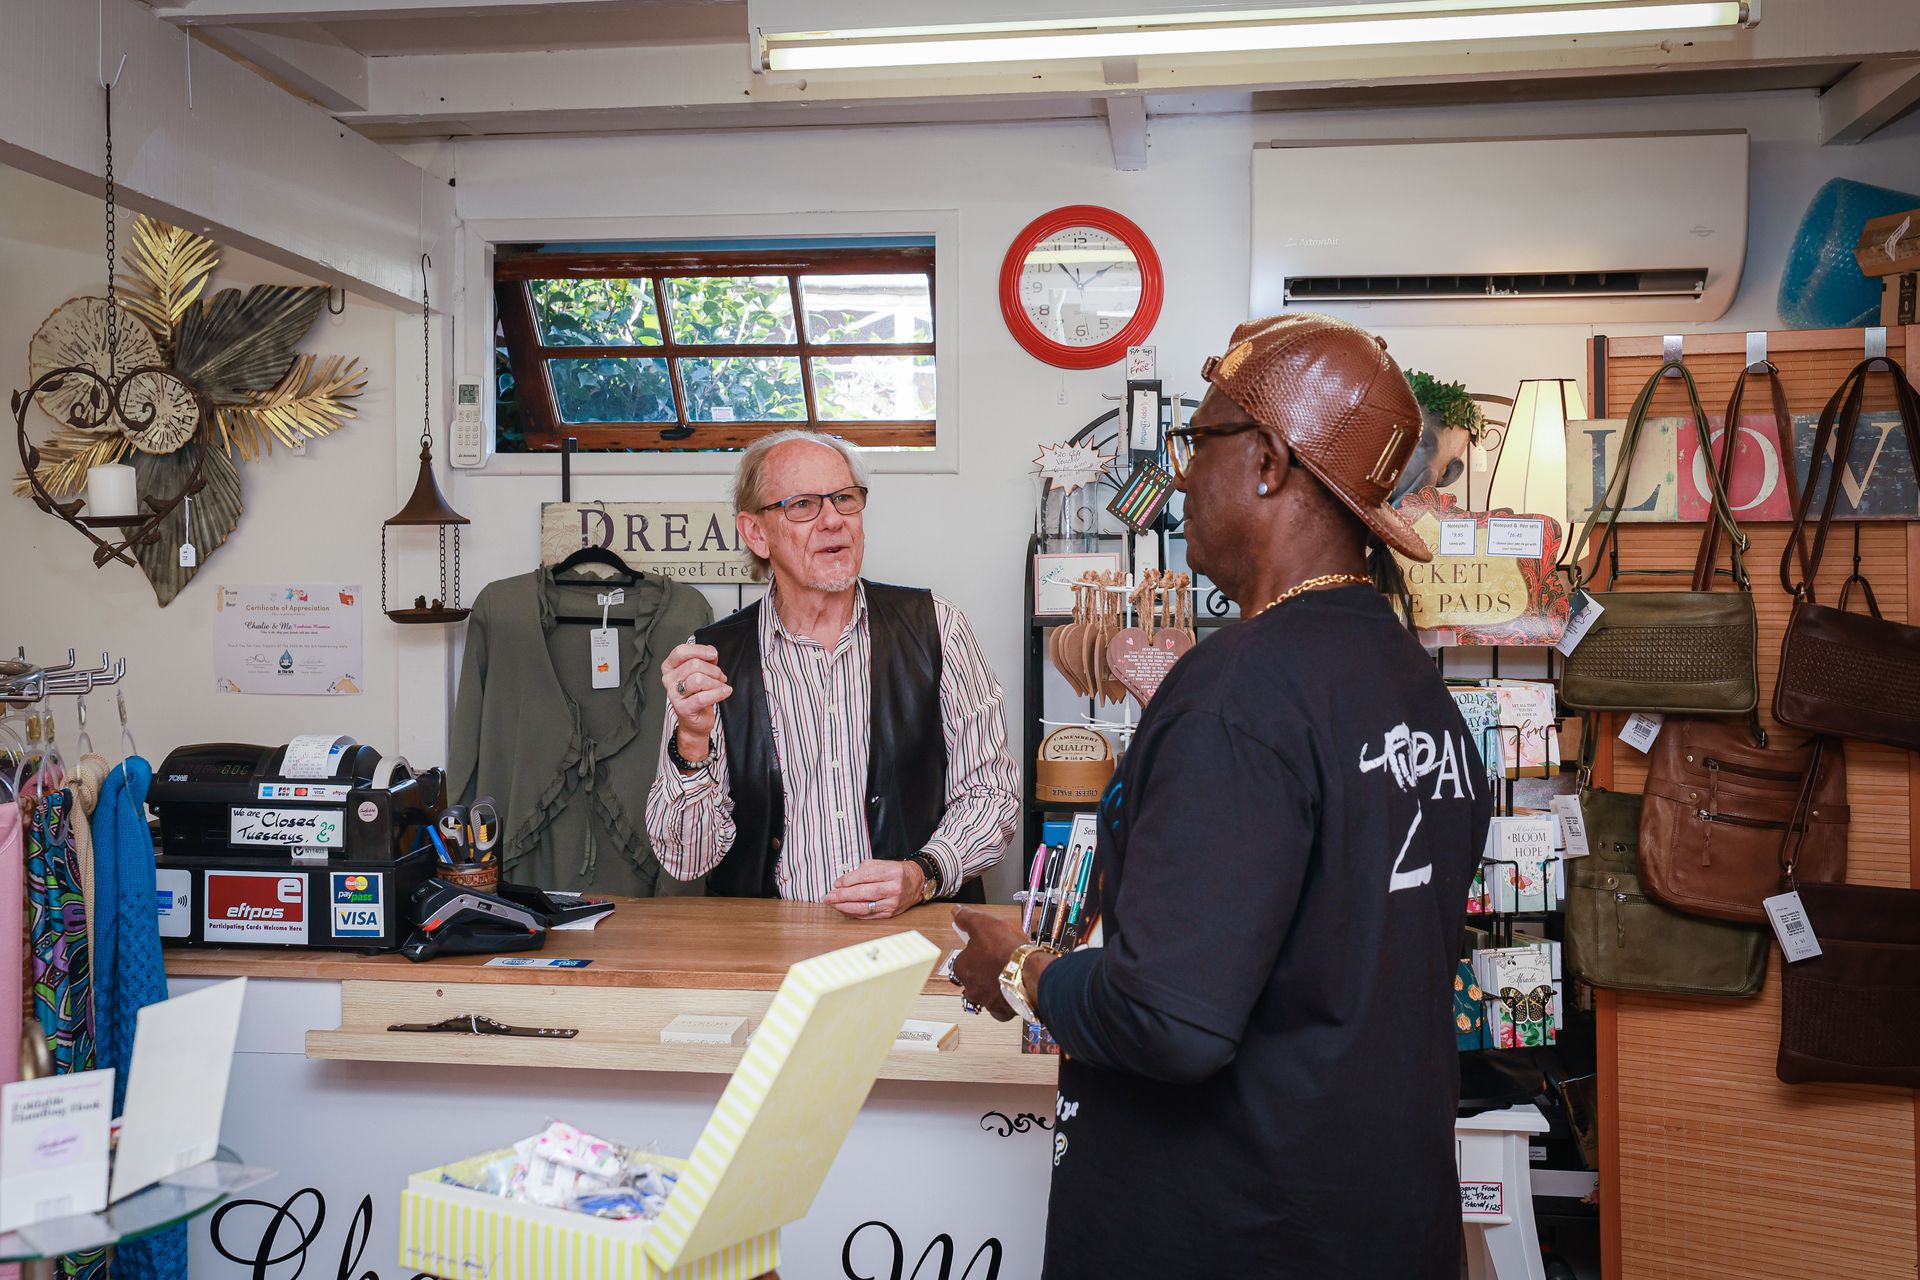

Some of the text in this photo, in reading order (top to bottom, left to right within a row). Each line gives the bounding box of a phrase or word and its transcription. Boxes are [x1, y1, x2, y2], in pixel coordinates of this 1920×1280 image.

[1074, 238, 1087, 249] 12
[1038, 263, 1052, 273] 10
[1032, 282, 1042, 293] 9
[1039, 304, 1050, 316] 8
[1099, 318, 1110, 330] 5
[1076, 325, 1086, 336] 6
[577, 508, 744, 552] DREA
[652, 562, 749, 577] sweet dre
[1397, 563, 1488, 584] CKET
[1438, 593, 1511, 613] PADS
[289, 604, 330, 614] Appreciation
[244, 621, 269, 630] Charlie
[1509, 719, 1549, 746] Love
[1053, 734, 1099, 743] CAMEMBERT
[1053, 744, 1097, 752] QUALITY
[1075, 789, 1098, 797] CHEESE
[247, 810, 261, 818] are
[261, 812, 319, 827] Closed
[1084, 826, 1095, 835] Sen
[1512, 832, 1546, 842] BLOOM
[1515, 846, 1543, 857] HOPE
[277, 878, 302, 903] e
[226, 903, 285, 920] eftpos
[338, 911, 378, 926] VISA
[209, 922, 245, 931] Participating
[1460, 1184, 1500, 1194] ogany French
[1484, 1203, 1501, 1211] $125
